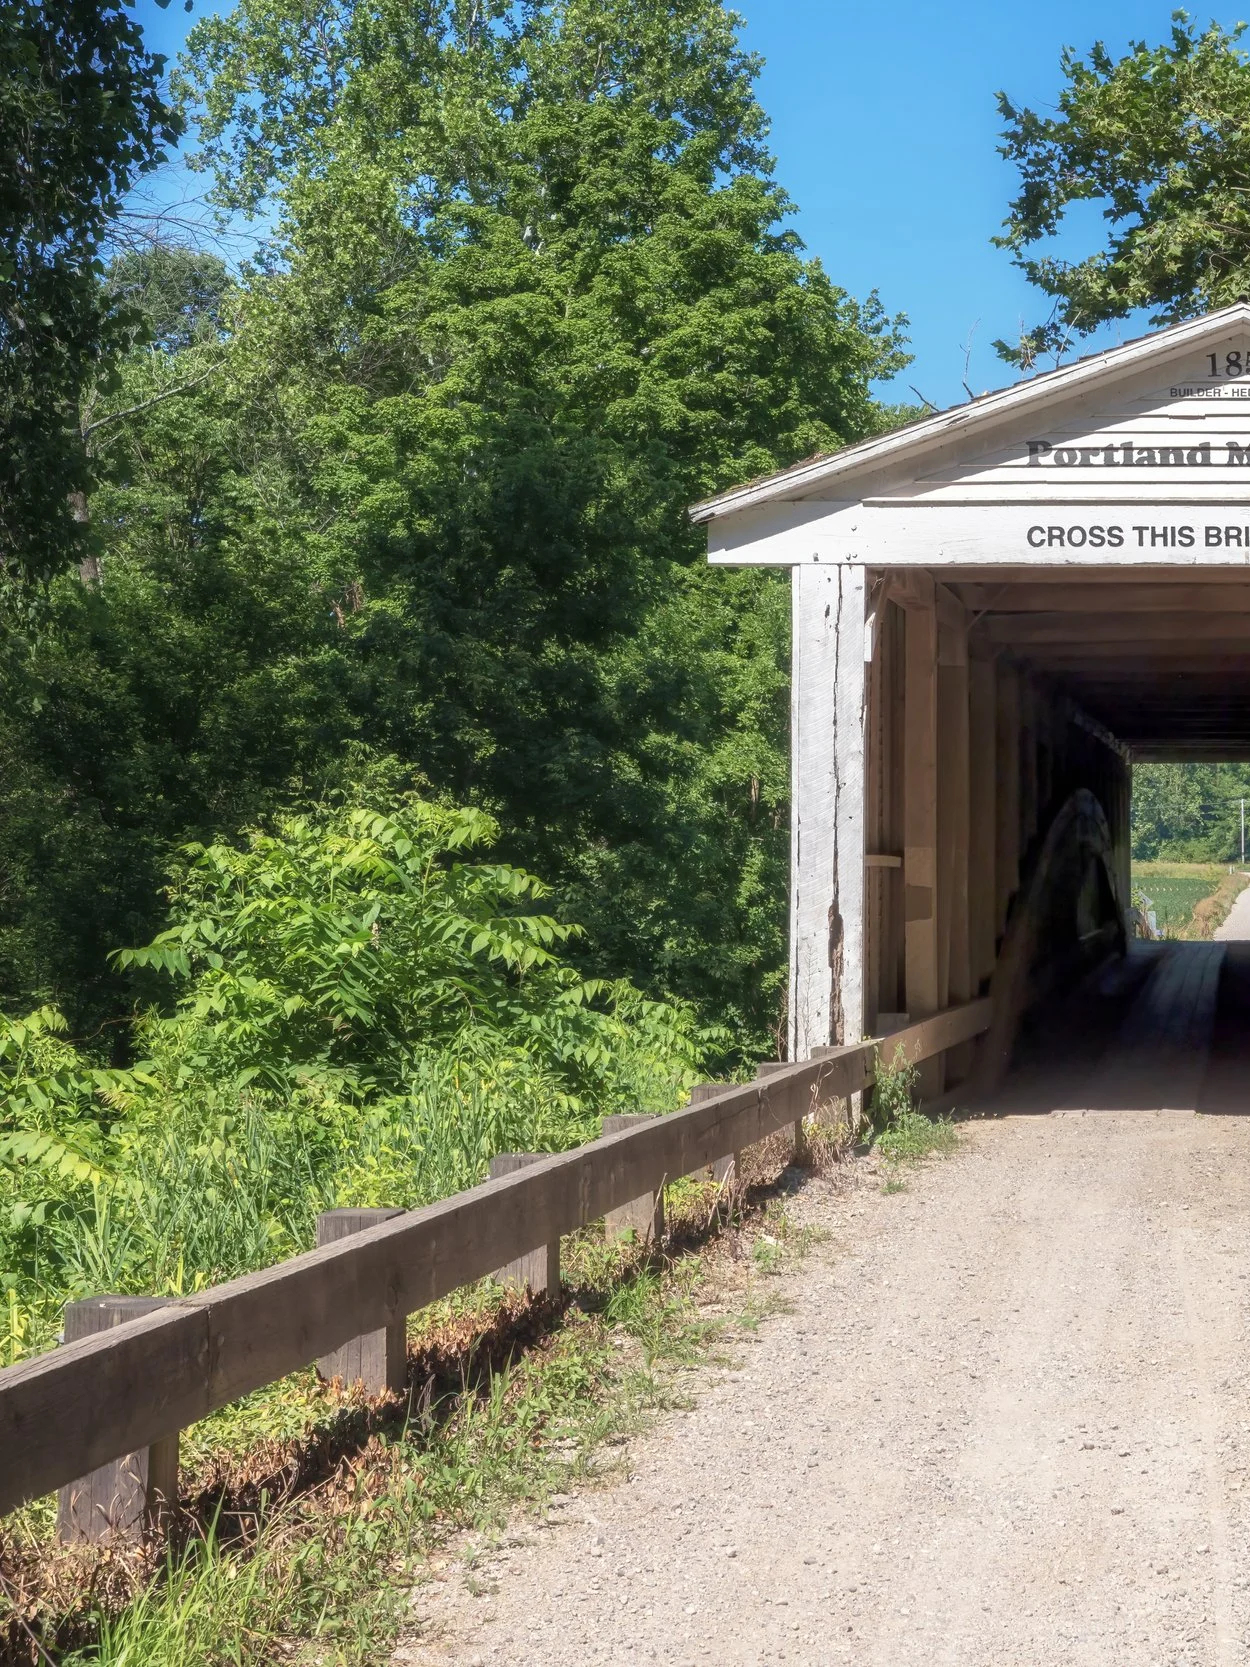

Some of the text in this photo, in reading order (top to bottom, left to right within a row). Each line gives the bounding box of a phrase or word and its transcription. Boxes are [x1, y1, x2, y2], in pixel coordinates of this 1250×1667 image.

[1170, 388, 1221, 397] BUILDER
[1026, 440, 1212, 467] Portland
[1027, 526, 1124, 547] CROSS
[1132, 526, 1195, 547] THIS
